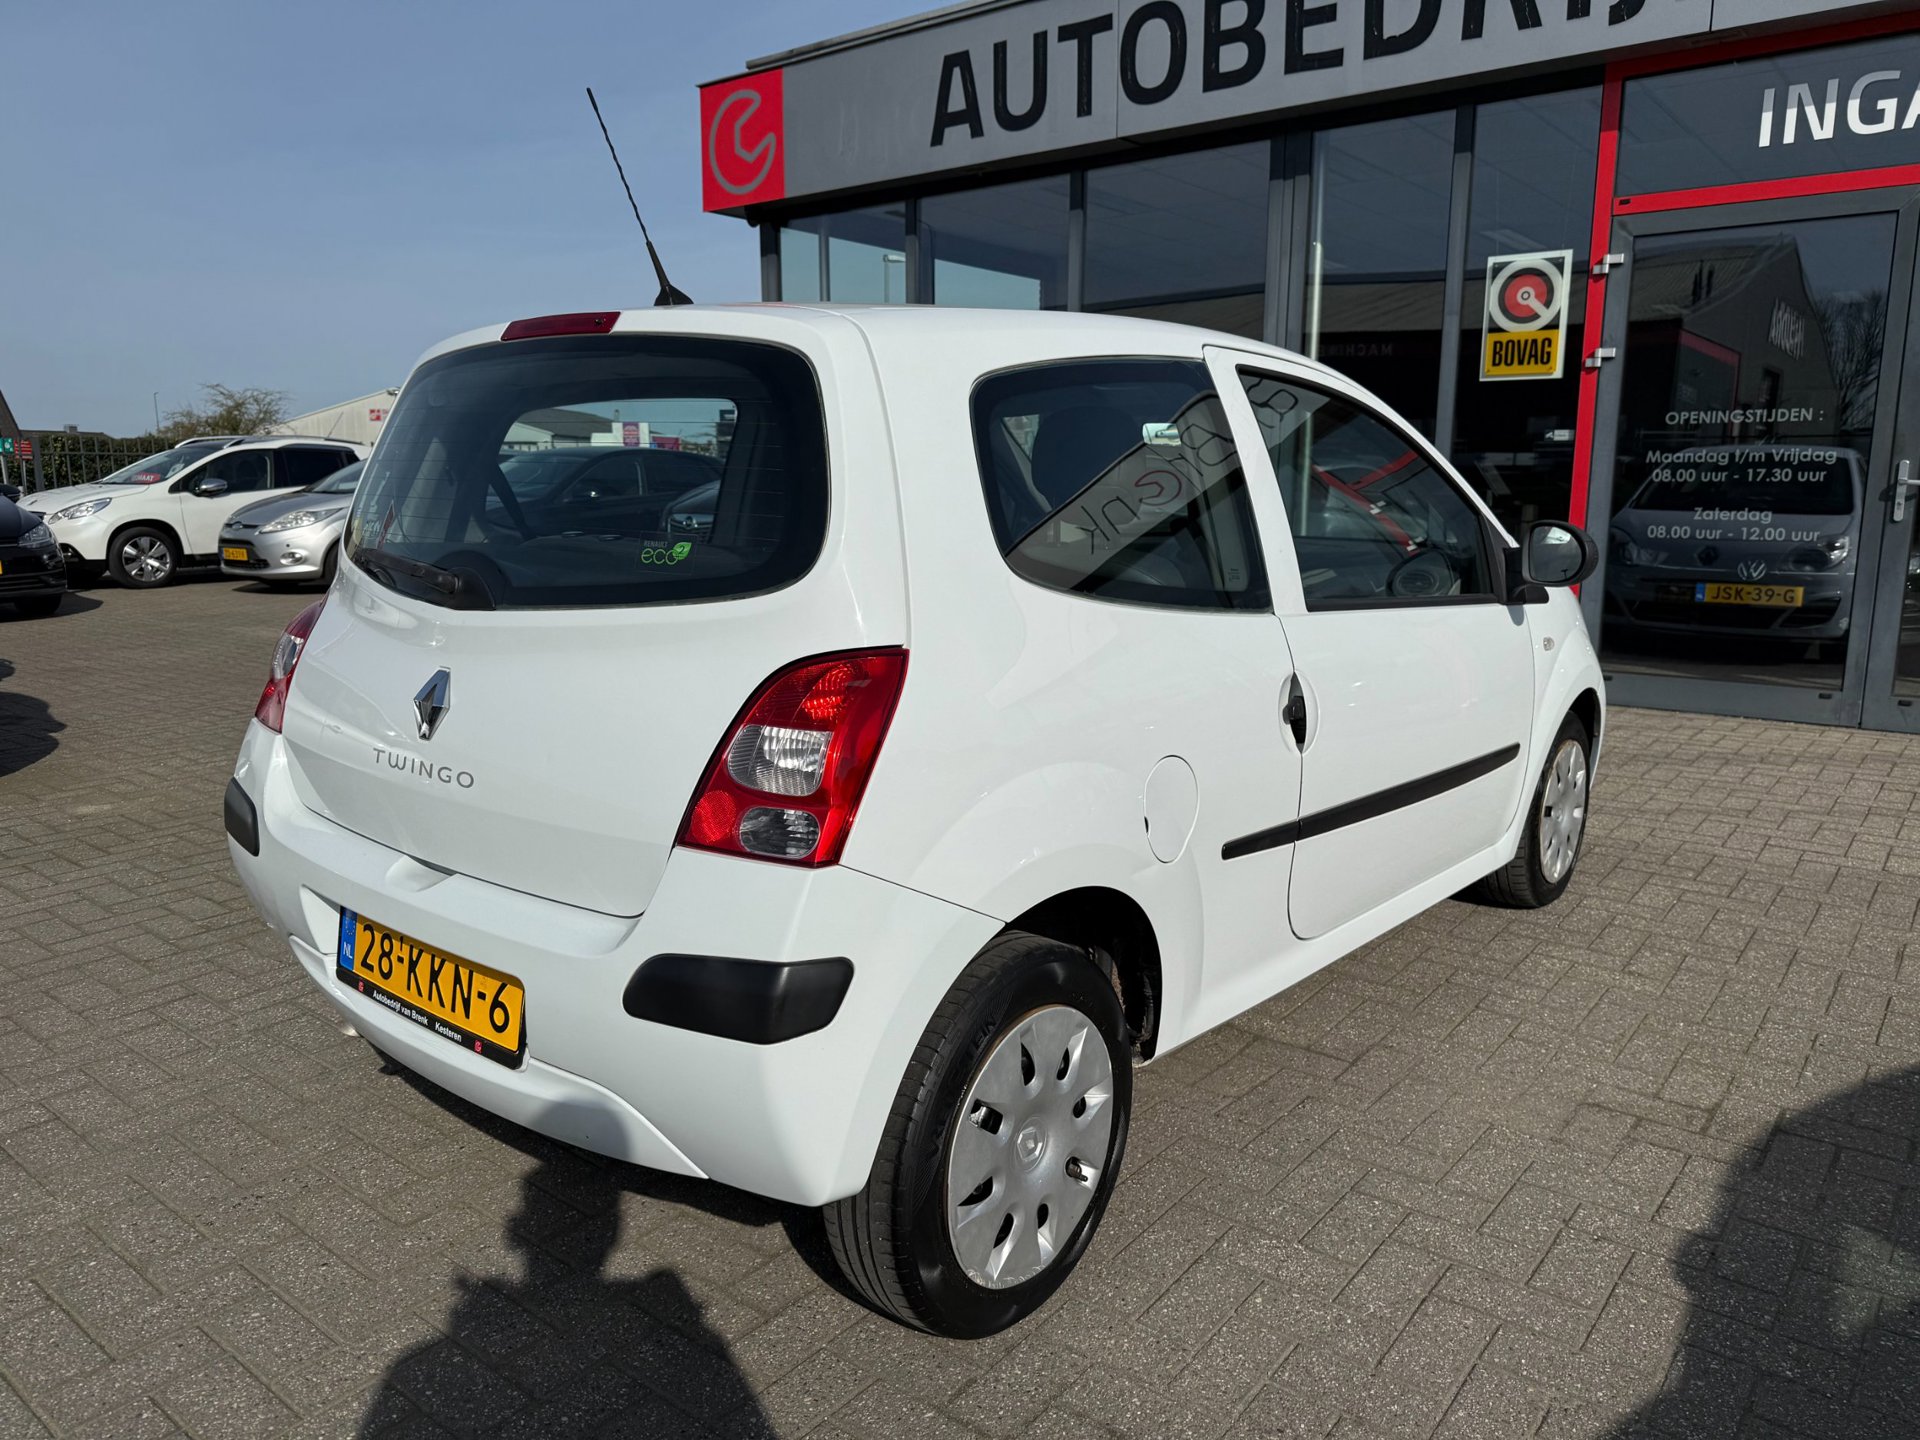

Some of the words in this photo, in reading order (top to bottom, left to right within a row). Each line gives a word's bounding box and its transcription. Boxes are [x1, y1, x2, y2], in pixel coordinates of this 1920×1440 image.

[930, 0, 1645, 147] AUTOBED
[1491, 337, 1553, 367] BOVAG
[1665, 408, 1814, 426] OPENINGSTIJDEN
[1645, 449, 1730, 466] Maandag
[1734, 449, 1766, 465] t/m
[1771, 448, 1837, 465] Vrijdag
[1652, 468, 1697, 483] 08.00
[1701, 470, 1729, 483] uur
[1747, 468, 1793, 483] 17.30
[1797, 469, 1828, 483] uur
[1694, 507, 1773, 525] Zaterdag
[1647, 525, 1691, 539] 08.00
[1695, 527, 1723, 540] uur
[1740, 527, 1786, 542] 12.00
[1791, 530, 1821, 542] uur
[641, 548, 679, 565] eco
[1711, 585, 1796, 604] JSK-39-G
[373, 747, 475, 789] TWINGO
[343, 941, 353, 960] NL
[360, 923, 511, 1034] 28-KKN-6
[372, 989, 401, 1012] Autobedrijf
[401, 1005, 412, 1017] van
[411, 1010, 429, 1026] Brenk
[435, 1021, 462, 1043] Kesteren
